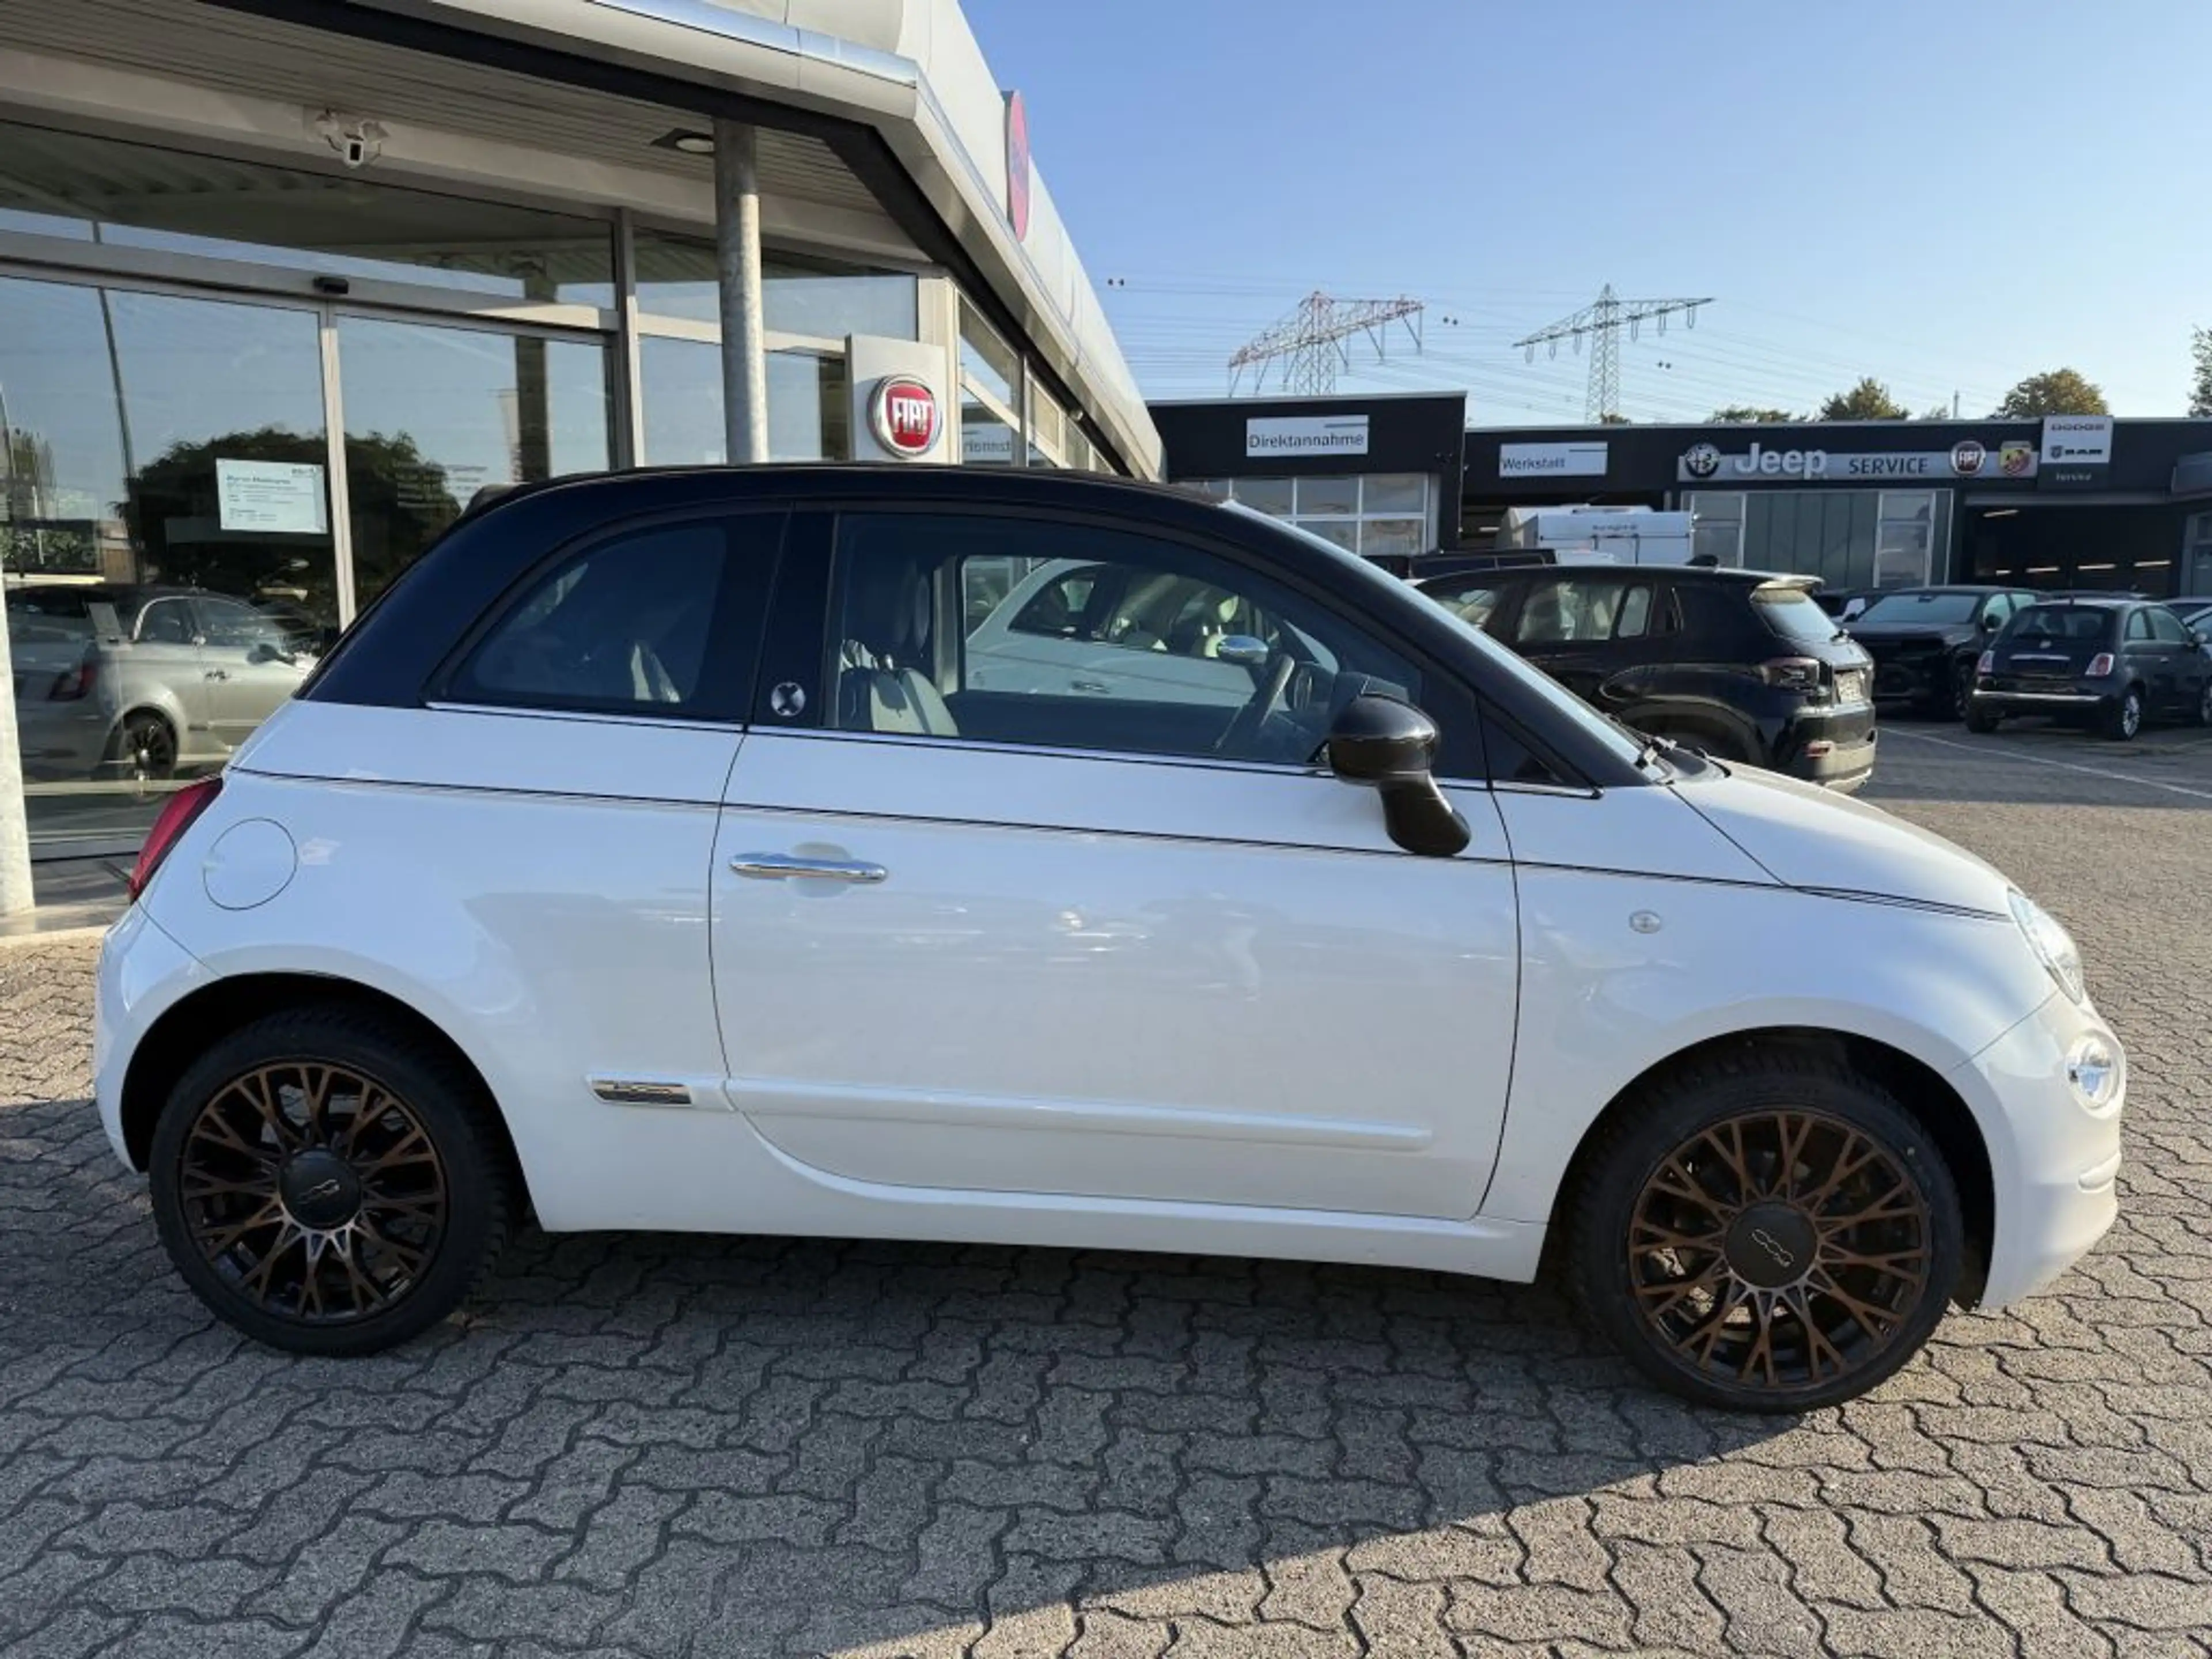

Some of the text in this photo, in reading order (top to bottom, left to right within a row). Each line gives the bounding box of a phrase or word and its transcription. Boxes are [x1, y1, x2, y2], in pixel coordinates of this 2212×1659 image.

[892, 396, 934, 434] FIAT
[1249, 433, 1364, 448] Direktannahme
[1501, 457, 1566, 471] Werkstatt
[1734, 442, 1928, 479] Jeep SERVICE
